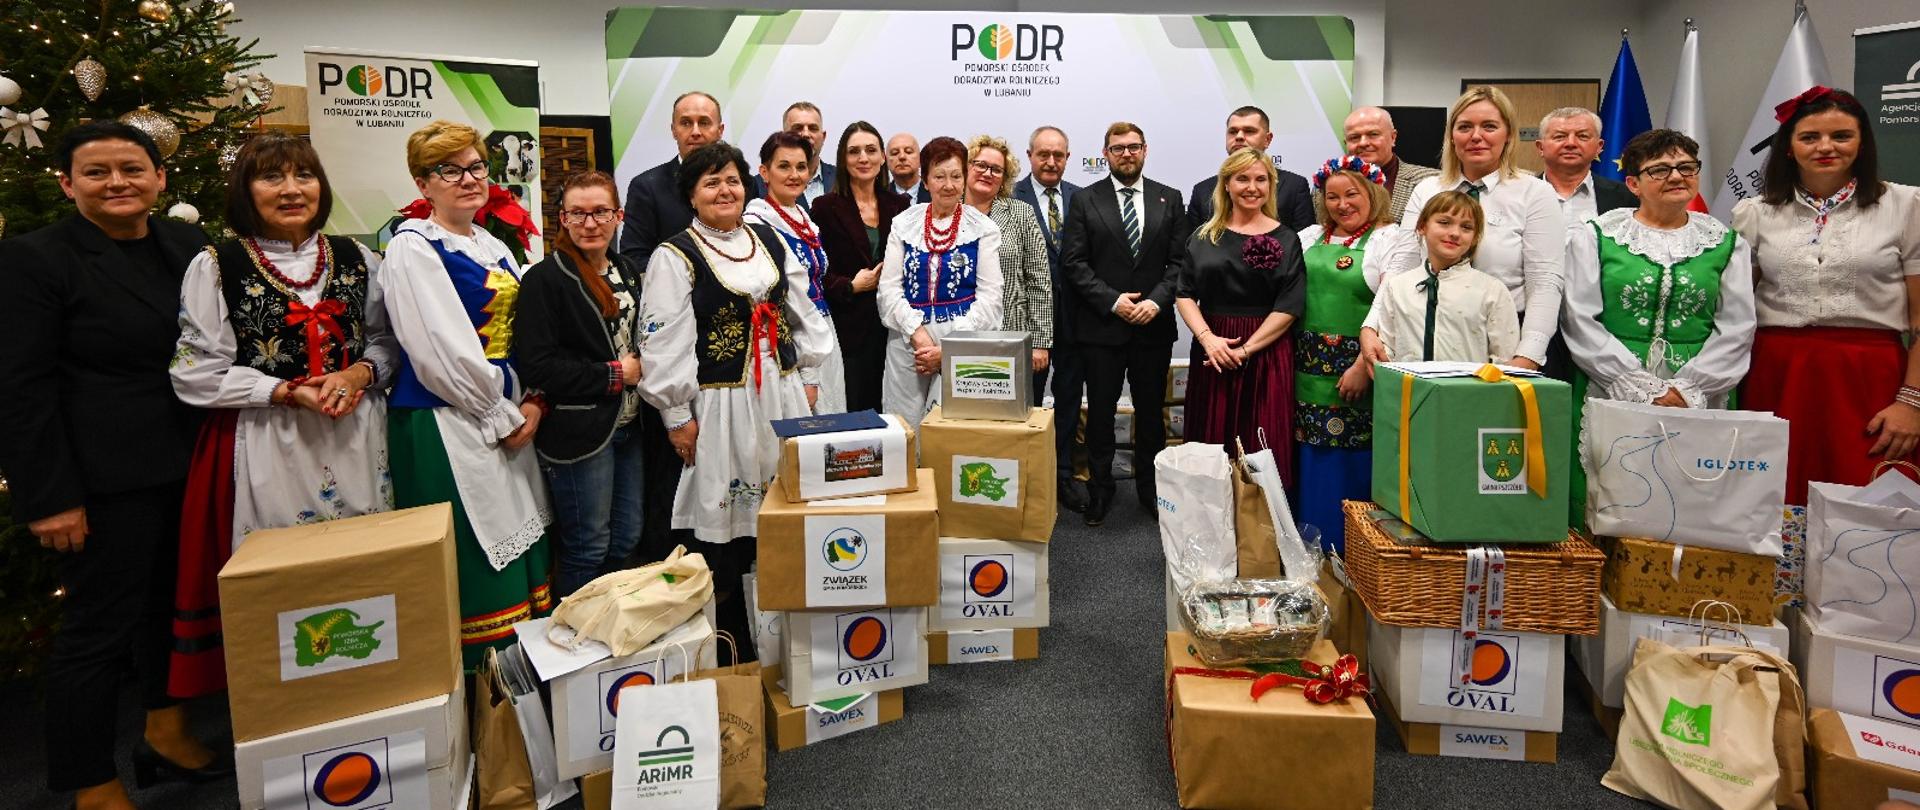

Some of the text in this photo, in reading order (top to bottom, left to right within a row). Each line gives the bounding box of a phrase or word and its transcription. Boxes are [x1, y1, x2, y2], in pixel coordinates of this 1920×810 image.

[964, 62, 1050, 72] POMORSKI OŚRODEK
[954, 75, 1060, 85] DORADZTWA ROLNICZEGO
[984, 88, 1031, 97] W LUBANIU
[334, 97, 380, 107] POMORSKI
[323, 108, 432, 119] DORADZTWA ROLNICZEGO
[356, 119, 404, 128] W LUBANIU
[823, 575, 868, 586] ZWIĄZEK
[962, 604, 1015, 618] OVAL
[961, 645, 1000, 655] SAWEX
[837, 663, 894, 686] OVAL
[1447, 690, 1515, 713] OVAL
[819, 707, 864, 728] SAWEX
[1455, 733, 1509, 746] SAWEX
[637, 764, 693, 785] ARiMR
